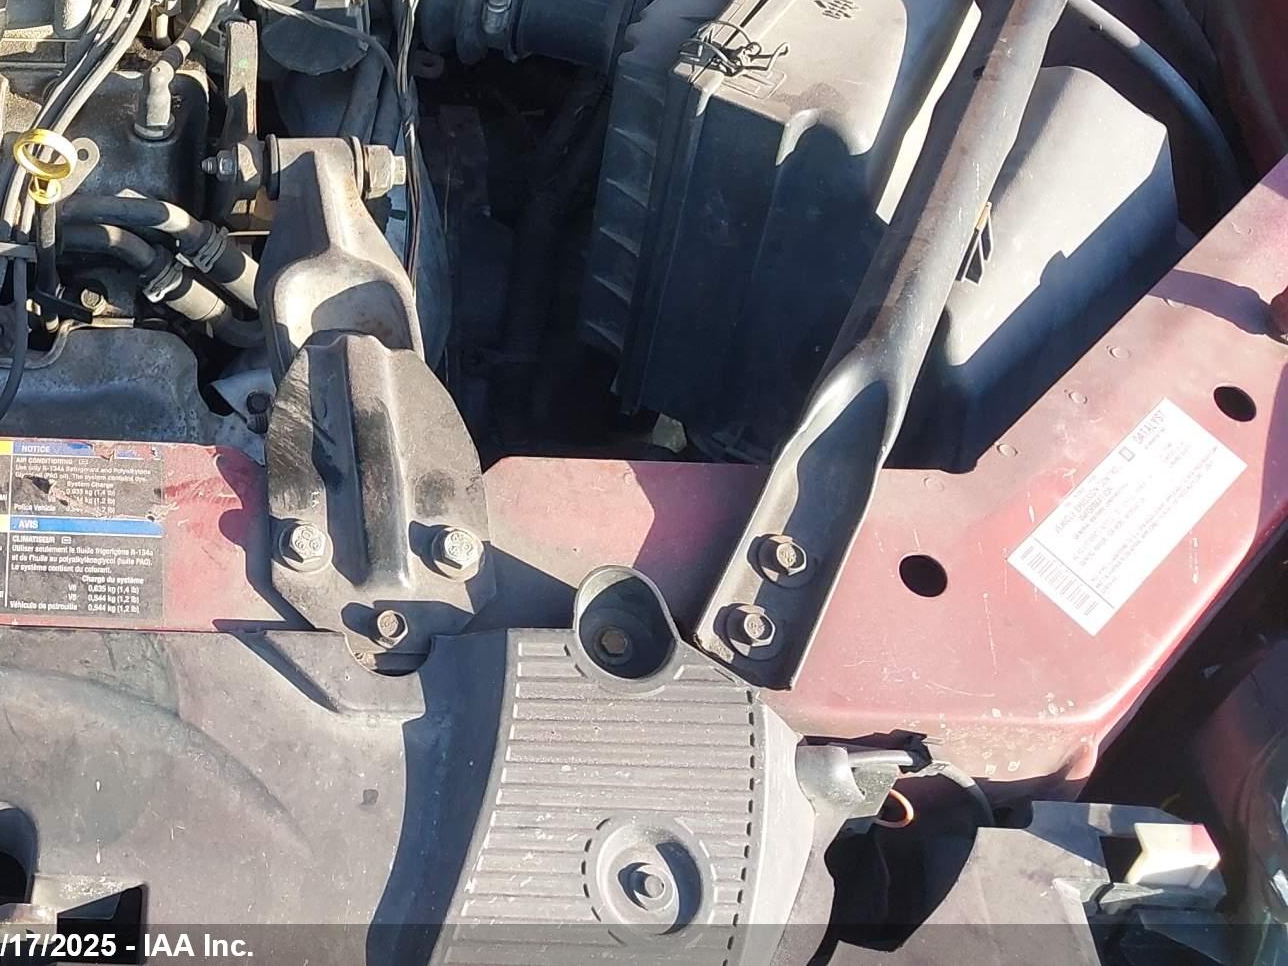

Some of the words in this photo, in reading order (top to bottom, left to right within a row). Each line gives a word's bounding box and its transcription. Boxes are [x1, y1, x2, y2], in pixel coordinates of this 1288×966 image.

[19, 520, 38, 528] AVIS
[12, 535, 55, 543] CLIMATISEUR
[82, 575, 105, 584] Charge
[108, 595, 116, 603] kg
[108, 605, 116, 613] kg
